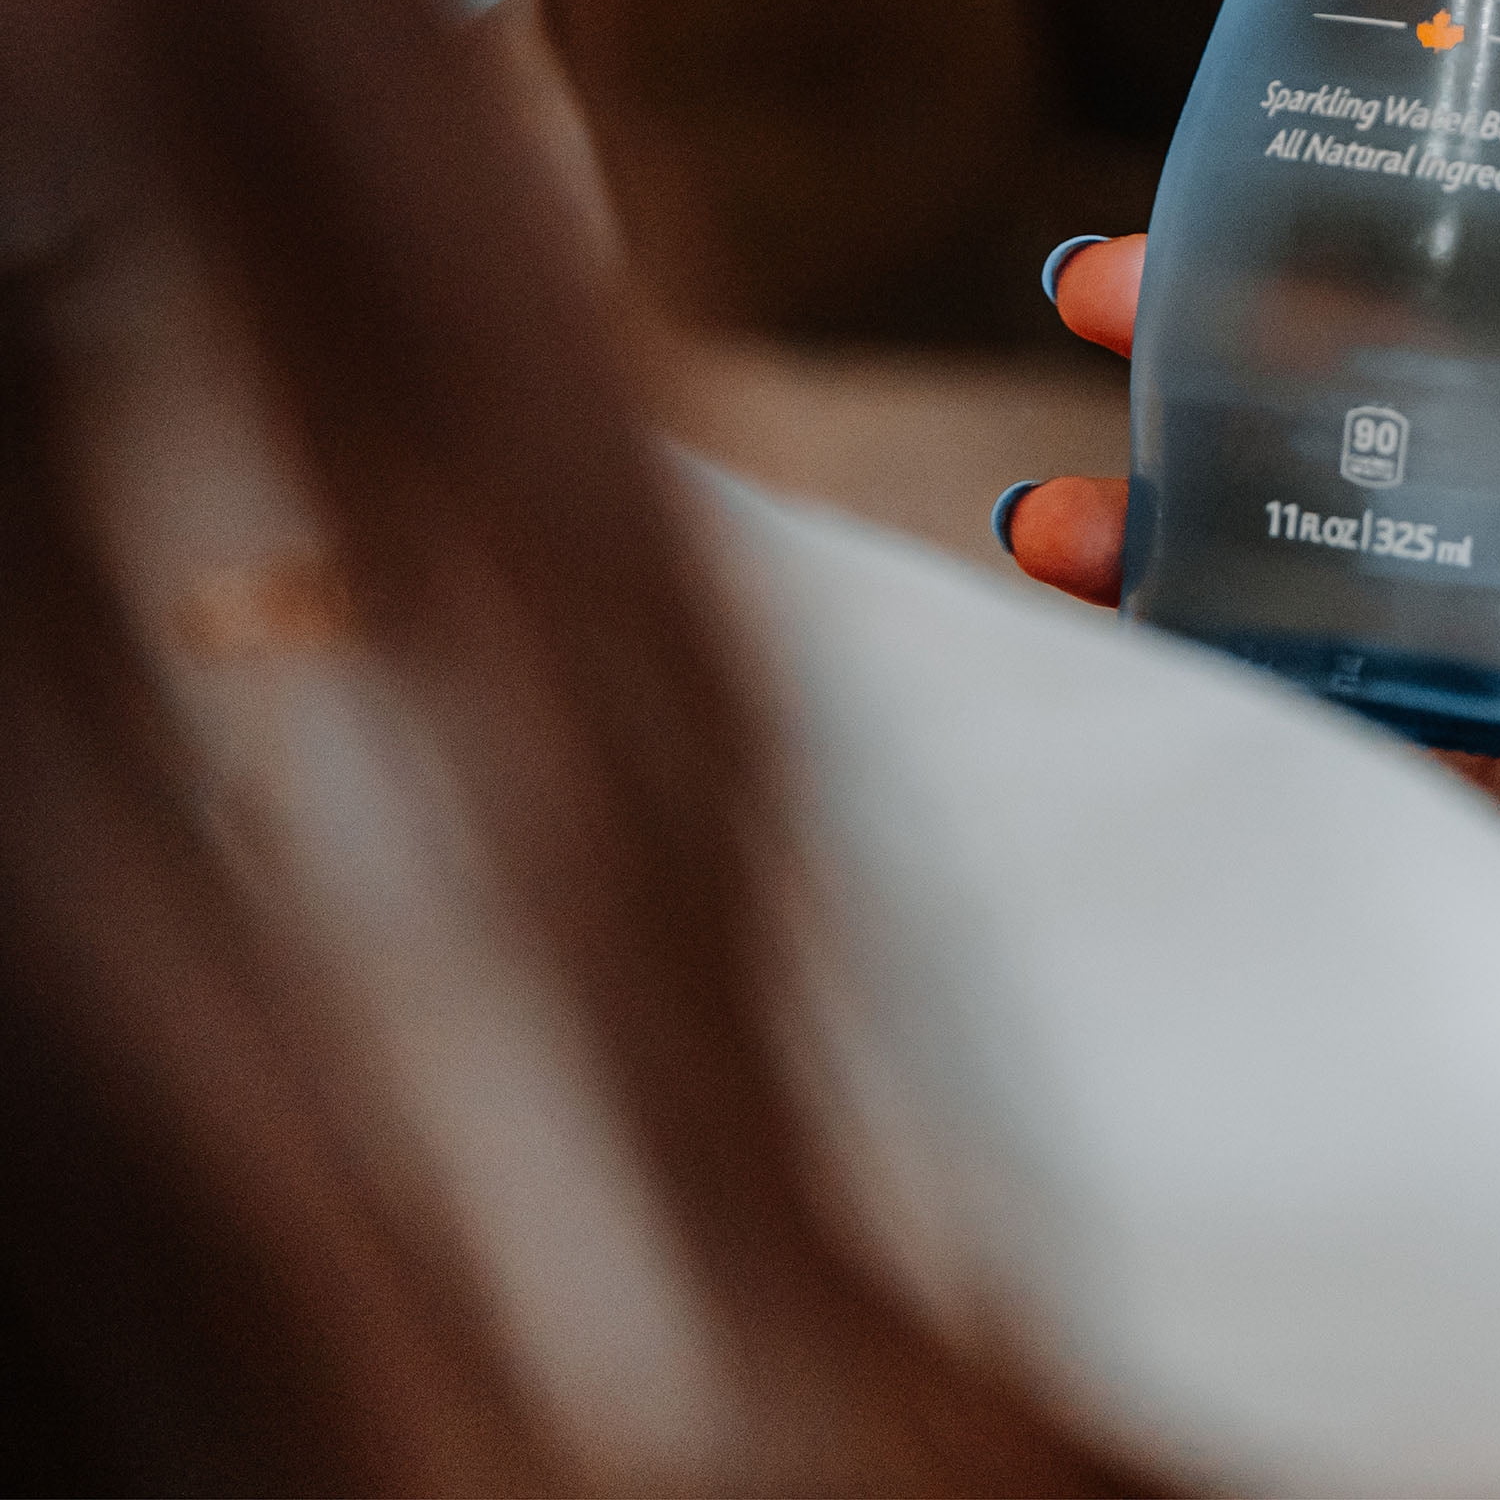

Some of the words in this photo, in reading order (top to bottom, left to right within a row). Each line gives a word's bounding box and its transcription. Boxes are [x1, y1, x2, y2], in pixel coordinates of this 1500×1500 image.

[1260, 80, 1380, 131] Sparkling
[1265, 128, 1307, 161] All
[1302, 132, 1417, 176] Natural
[1354, 417, 1399, 455] 90
